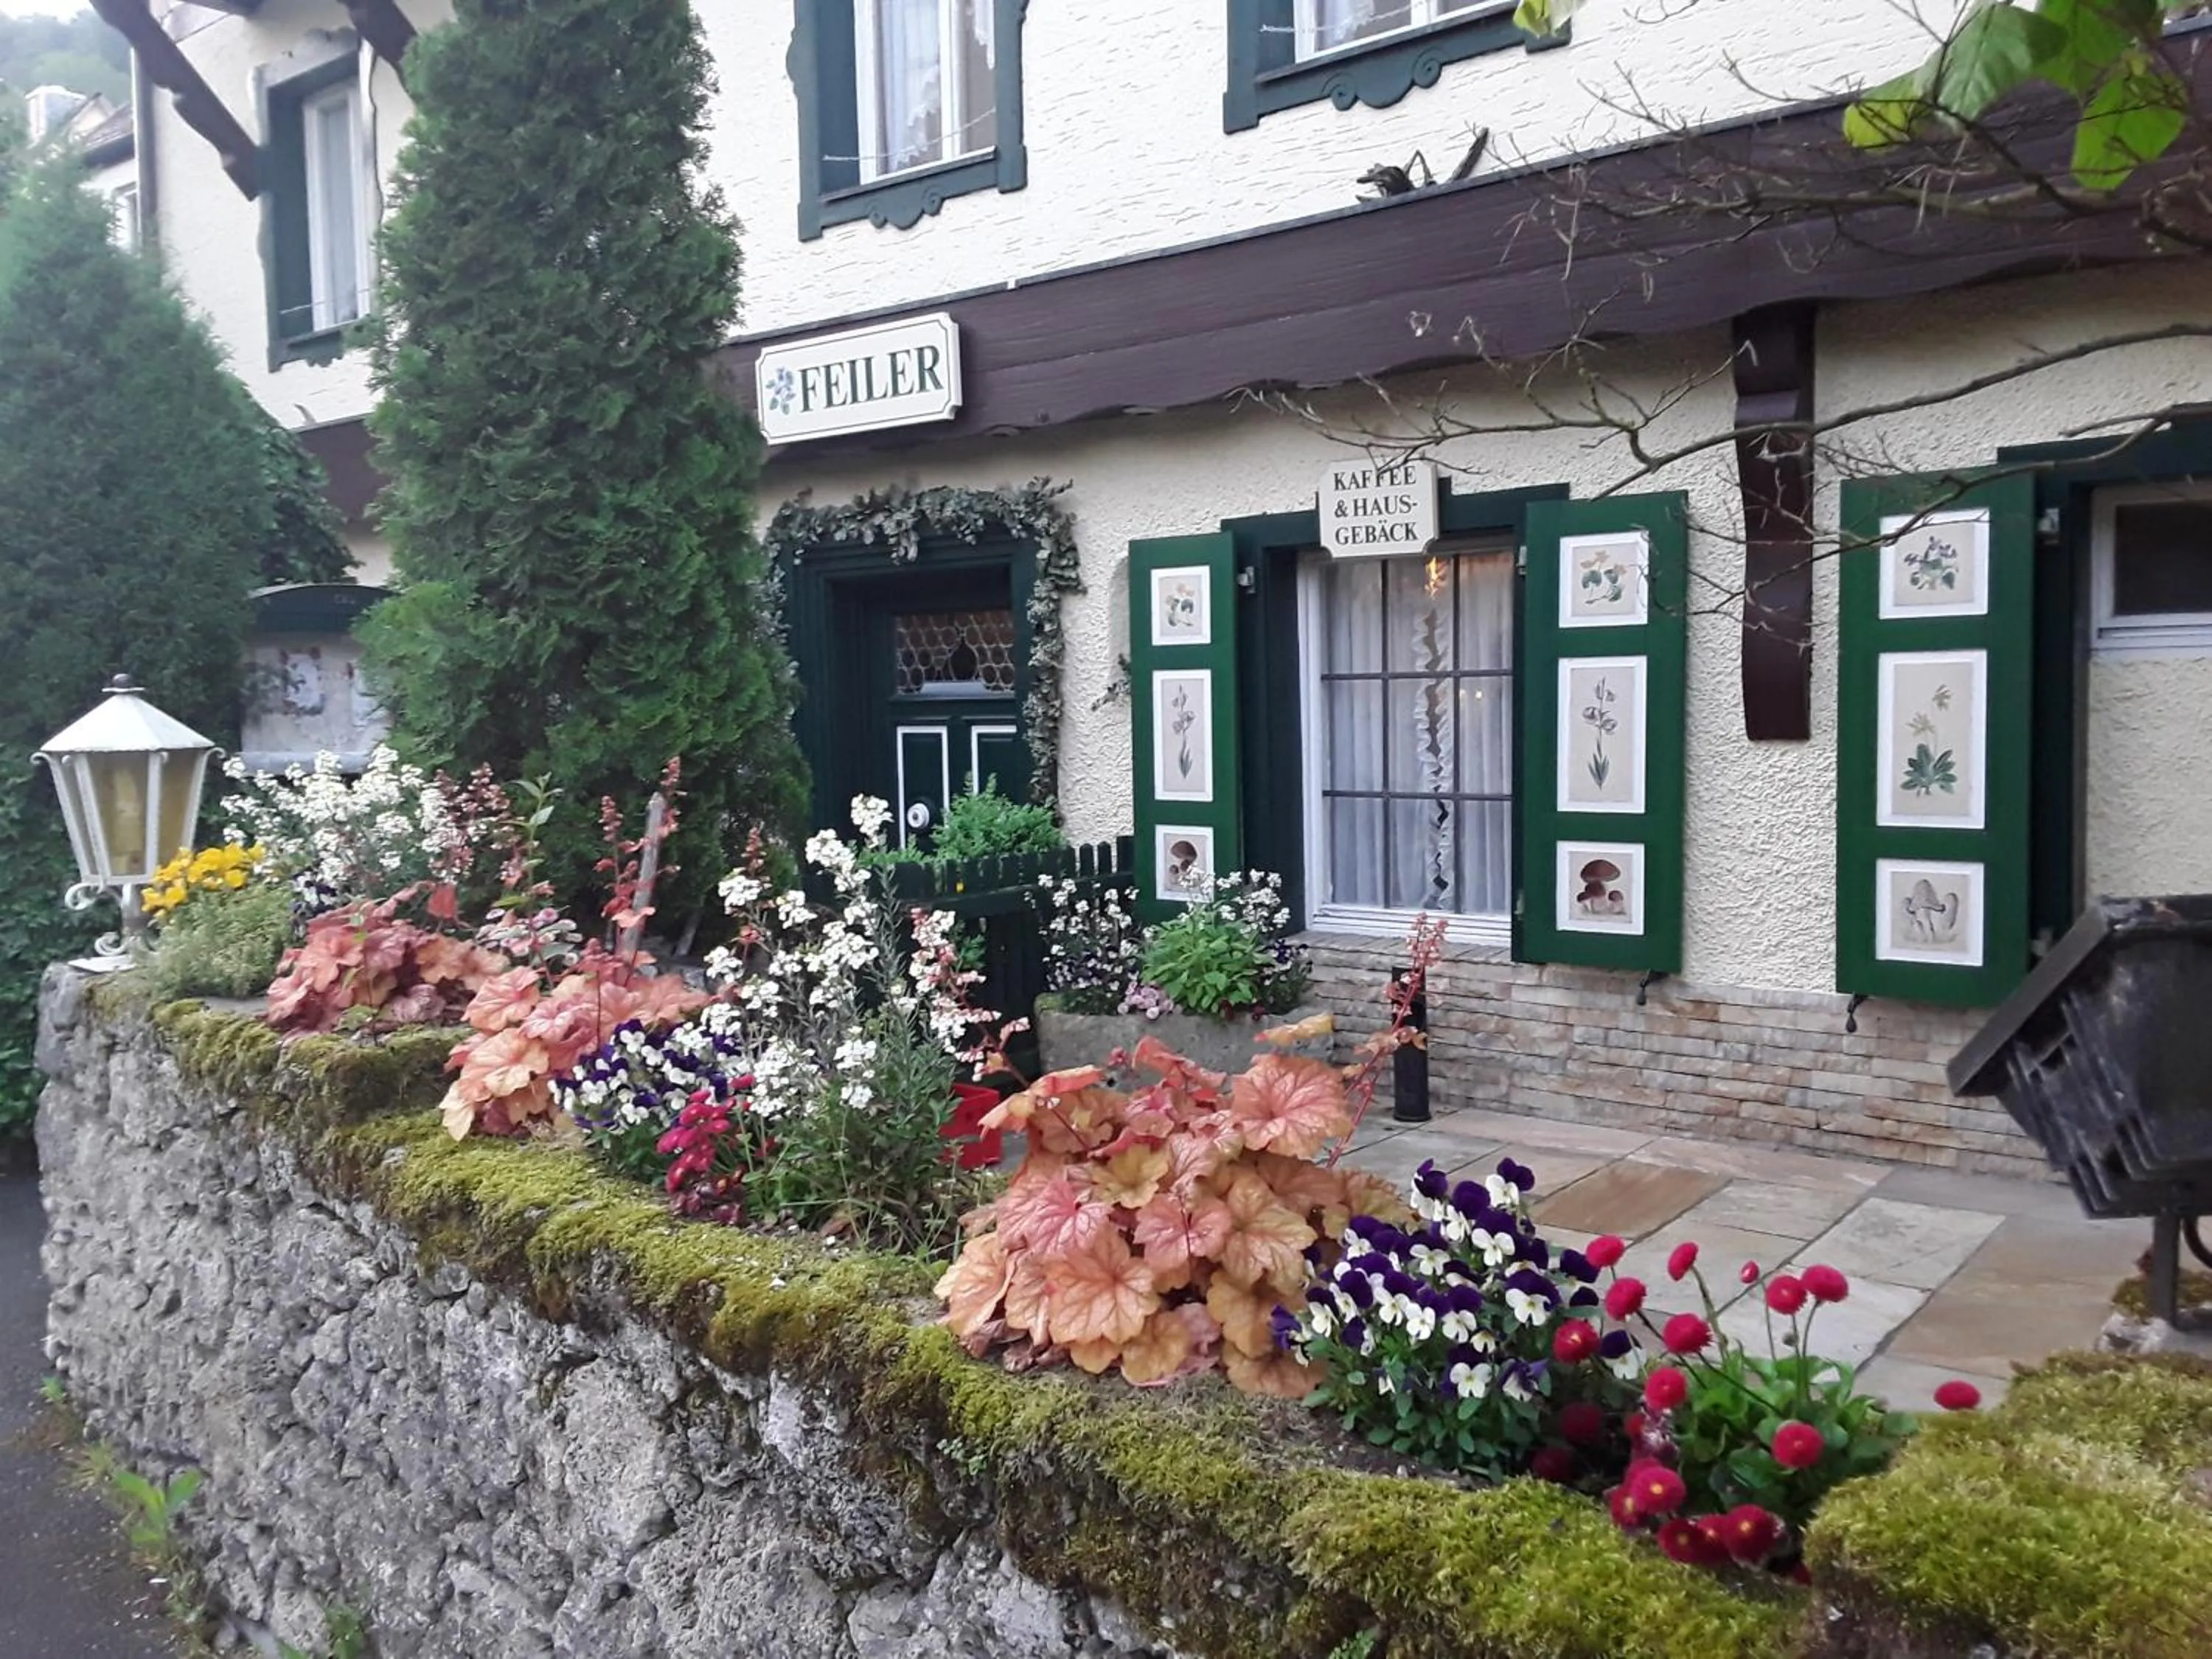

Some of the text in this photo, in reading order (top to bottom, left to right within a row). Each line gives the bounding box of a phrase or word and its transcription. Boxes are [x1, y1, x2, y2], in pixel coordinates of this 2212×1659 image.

[798, 344, 944, 414] FEILER
[1333, 465, 1416, 491] KAFFEE
[1334, 494, 1418, 518] & HAUS-
[1335, 519, 1418, 546] GEBÄCK
